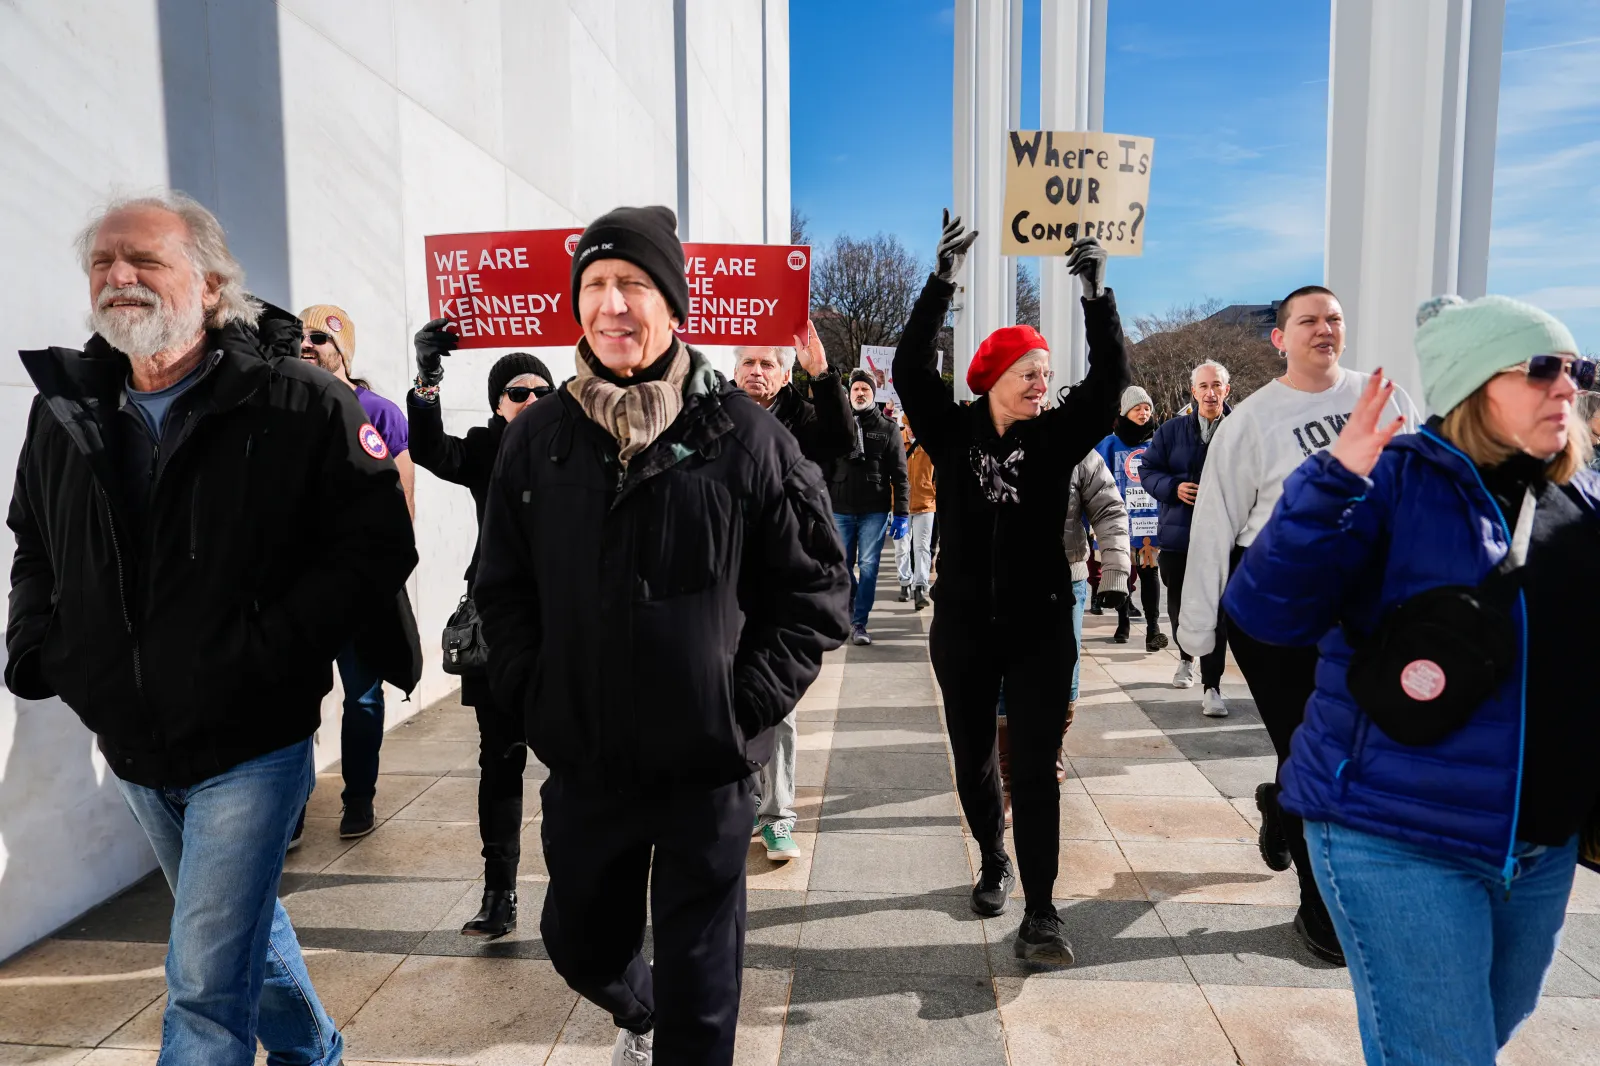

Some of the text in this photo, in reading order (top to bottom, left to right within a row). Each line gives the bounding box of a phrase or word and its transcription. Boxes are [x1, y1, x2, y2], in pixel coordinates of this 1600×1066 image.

[1010, 131, 1149, 175] Where Is
[1045, 175, 1100, 205] OUR
[434, 247, 529, 271] WE ARE
[713, 257, 757, 276] ARE
[436, 273, 483, 296] THE
[686, 277, 714, 295] HE
[439, 293, 561, 319] KENNEDY
[688, 297, 779, 316] ENNEDY
[866, 347, 888, 355] FULL
[1292, 412, 1352, 457] IOW
